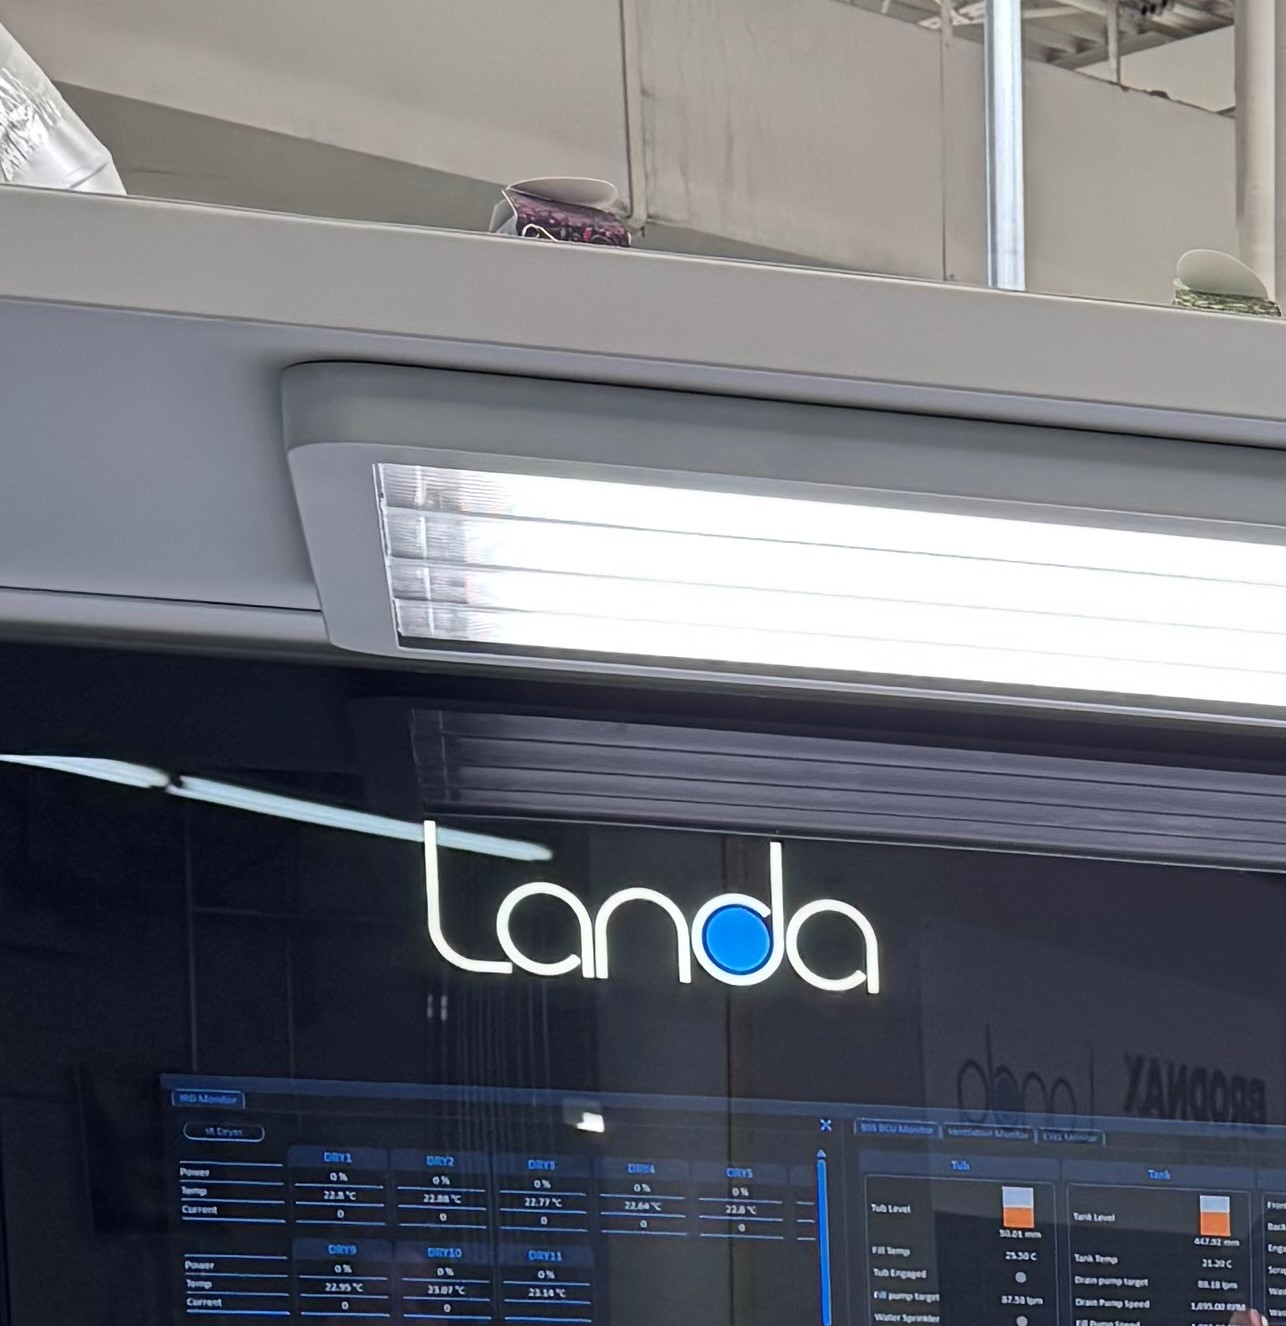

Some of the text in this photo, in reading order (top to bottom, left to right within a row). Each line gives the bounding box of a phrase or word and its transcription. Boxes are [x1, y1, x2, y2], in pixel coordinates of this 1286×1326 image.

[423, 820, 880, 994] Landa
[951, 1161, 970, 1171] Tub
[180, 1168, 209, 1178] Power
[1149, 1169, 1171, 1180] Tank
[181, 1186, 207, 1196] Temp
[182, 1205, 218, 1215] Current
[871, 1204, 911, 1214] Tub Level
[1073, 1213, 1115, 1222] Tank Level
[887, 1247, 910, 1257] Temp
[1075, 1254, 1118, 1265] Tank Temp
[185, 1260, 215, 1270] Power
[186, 1297, 222, 1308] Current
[888, 1293, 912, 1302] pump
[914, 1293, 940, 1302] target
[875, 1314, 901, 1323] Water
